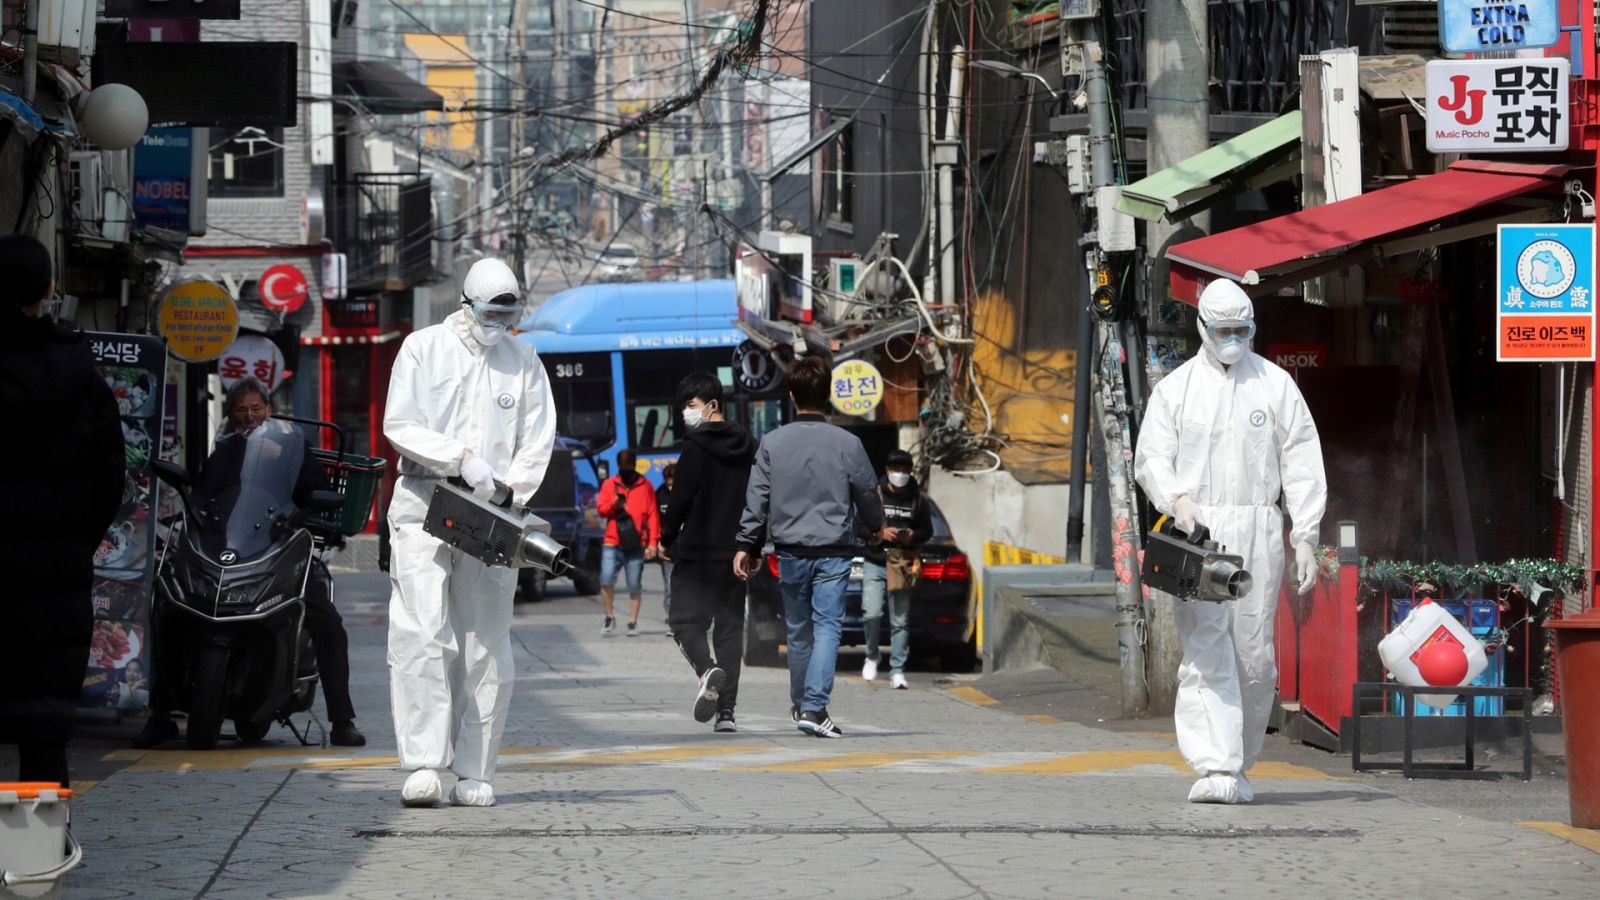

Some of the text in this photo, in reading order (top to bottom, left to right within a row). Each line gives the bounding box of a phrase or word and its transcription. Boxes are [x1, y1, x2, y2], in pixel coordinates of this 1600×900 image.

[1471, 4, 1530, 26] EXTRA
[1478, 25, 1526, 45] COLD
[1492, 65, 1559, 106] 뮤직
[1437, 74, 1487, 126] JJ
[1435, 130, 1490, 139] Music Pocha
[1493, 105, 1561, 145] 포차
[135, 181, 190, 199] NOBEL
[1504, 285, 1590, 309] 眞 露
[173, 310, 226, 321] RESTAURANT
[1506, 326, 1586, 342] 진로 이즈 백
[555, 363, 584, 378] 386
[1275, 354, 1319, 368] NSOK
[834, 375, 878, 399] 환전
